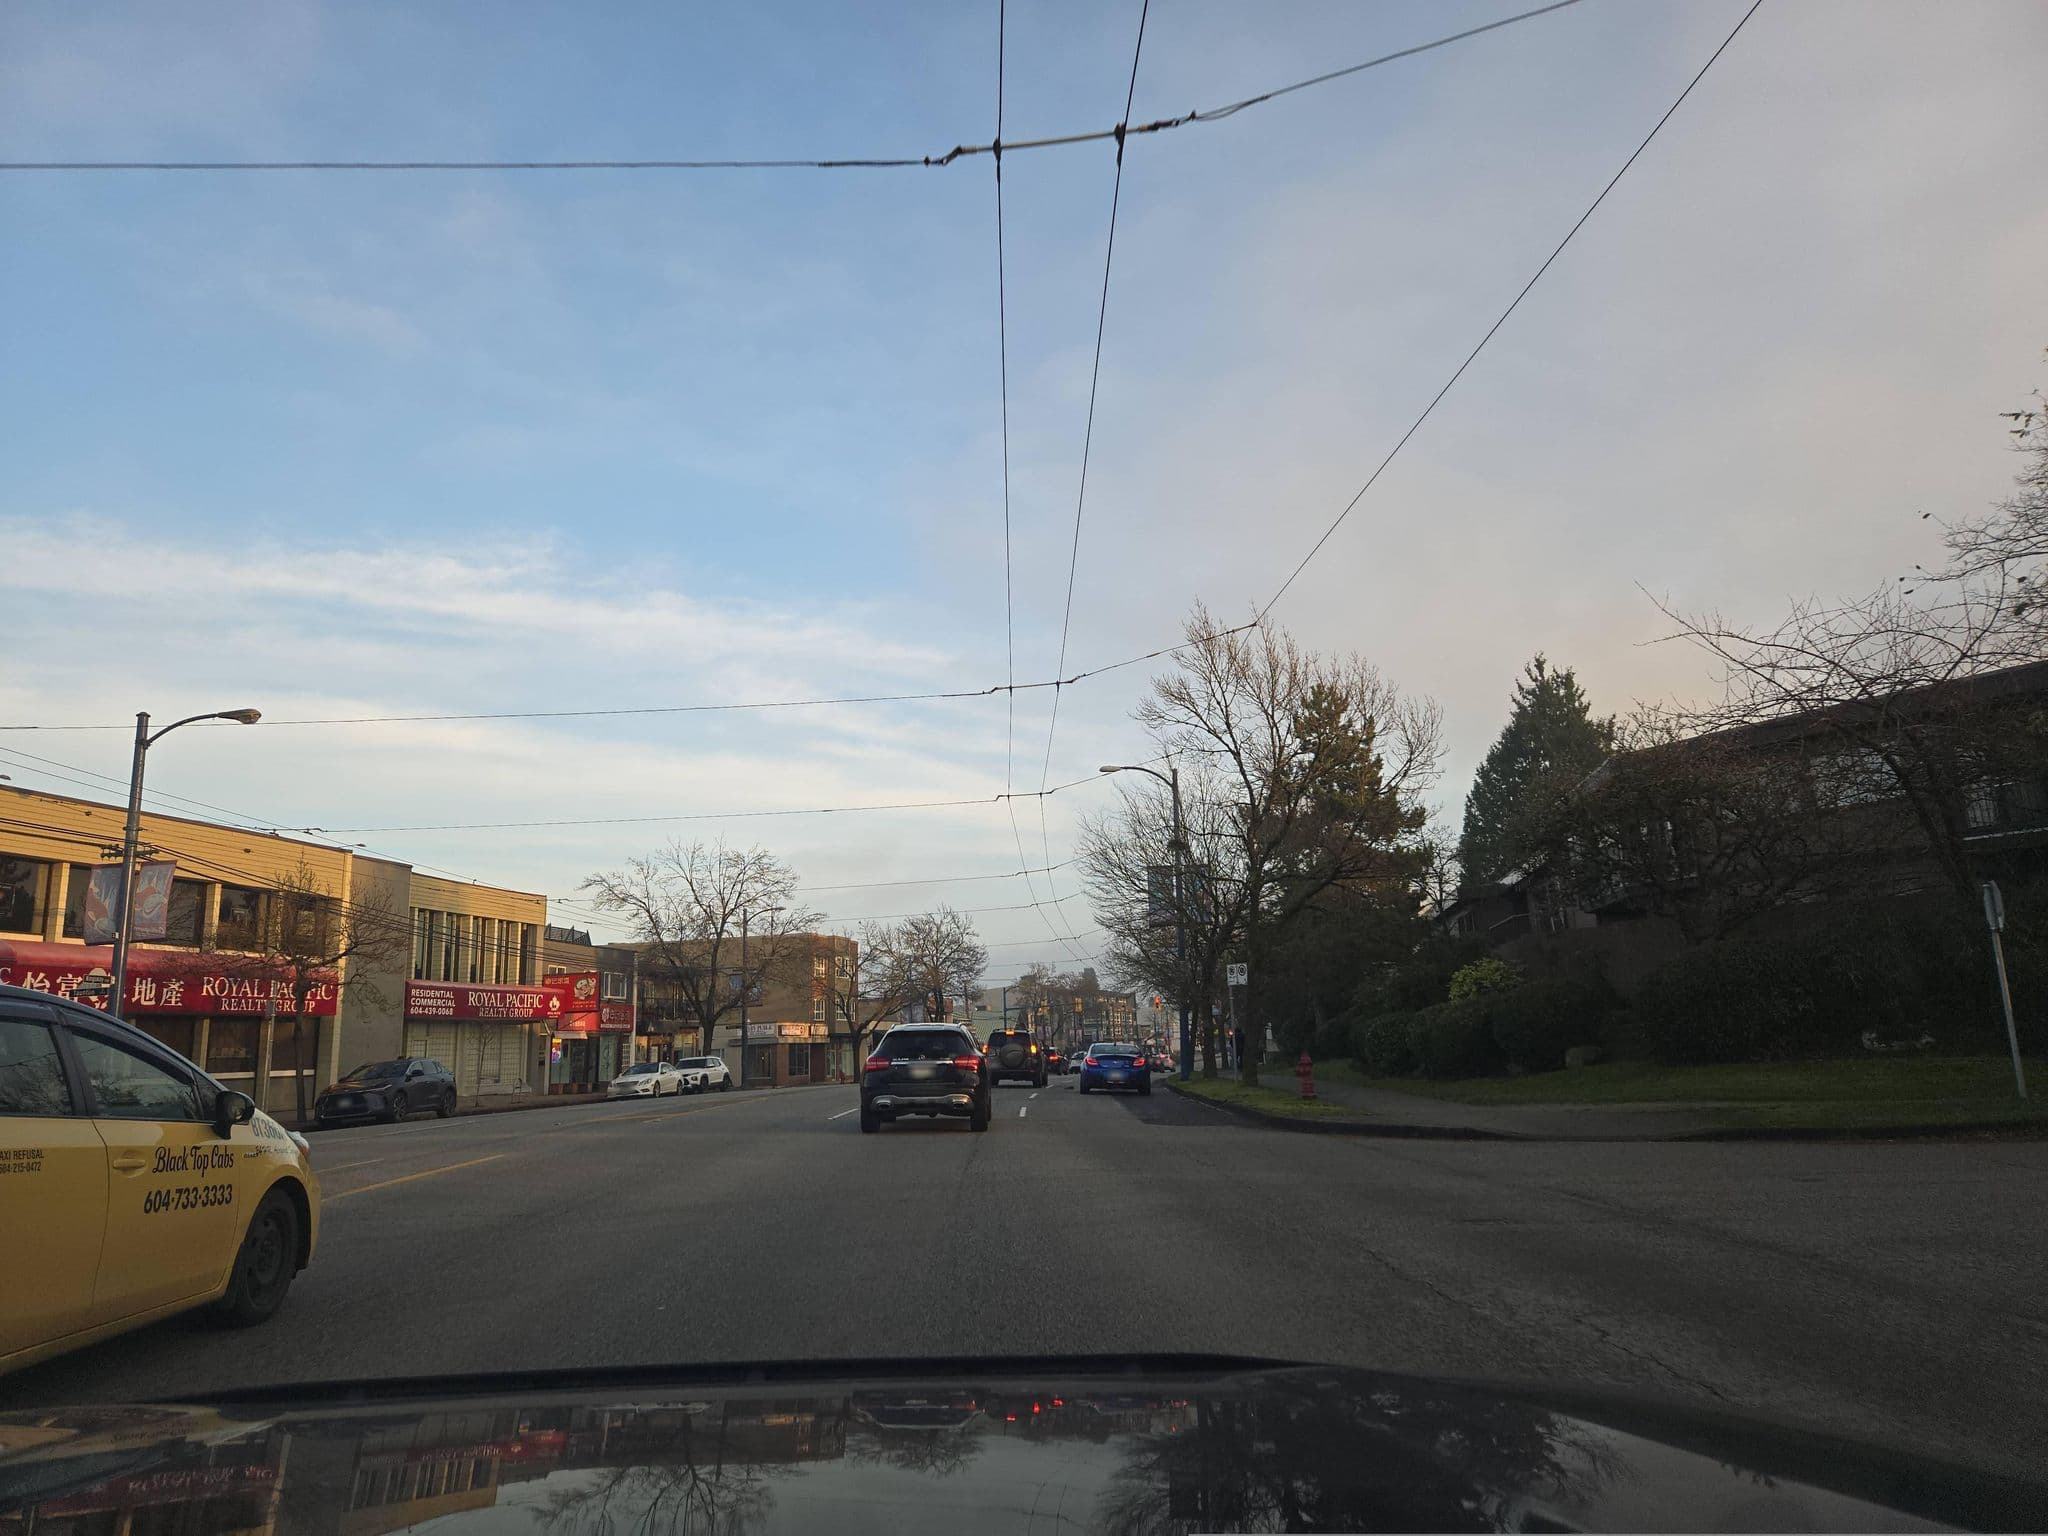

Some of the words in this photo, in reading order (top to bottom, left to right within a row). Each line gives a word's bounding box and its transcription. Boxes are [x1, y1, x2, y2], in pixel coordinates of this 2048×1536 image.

[201, 976, 265, 998] ROYAL
[411, 989, 454, 999] RESIDENTIAL
[410, 998, 456, 1007] COMMERCIAL
[468, 991, 504, 1006] ROYAL
[506, 993, 544, 1008] PACIFIC
[479, 1007, 508, 1017] REALTY
[509, 1008, 534, 1018] GROUP
[152, 1145, 189, 1174] Black
[190, 1145, 209, 1178] Top
[211, 1144, 235, 1169] Cabs
